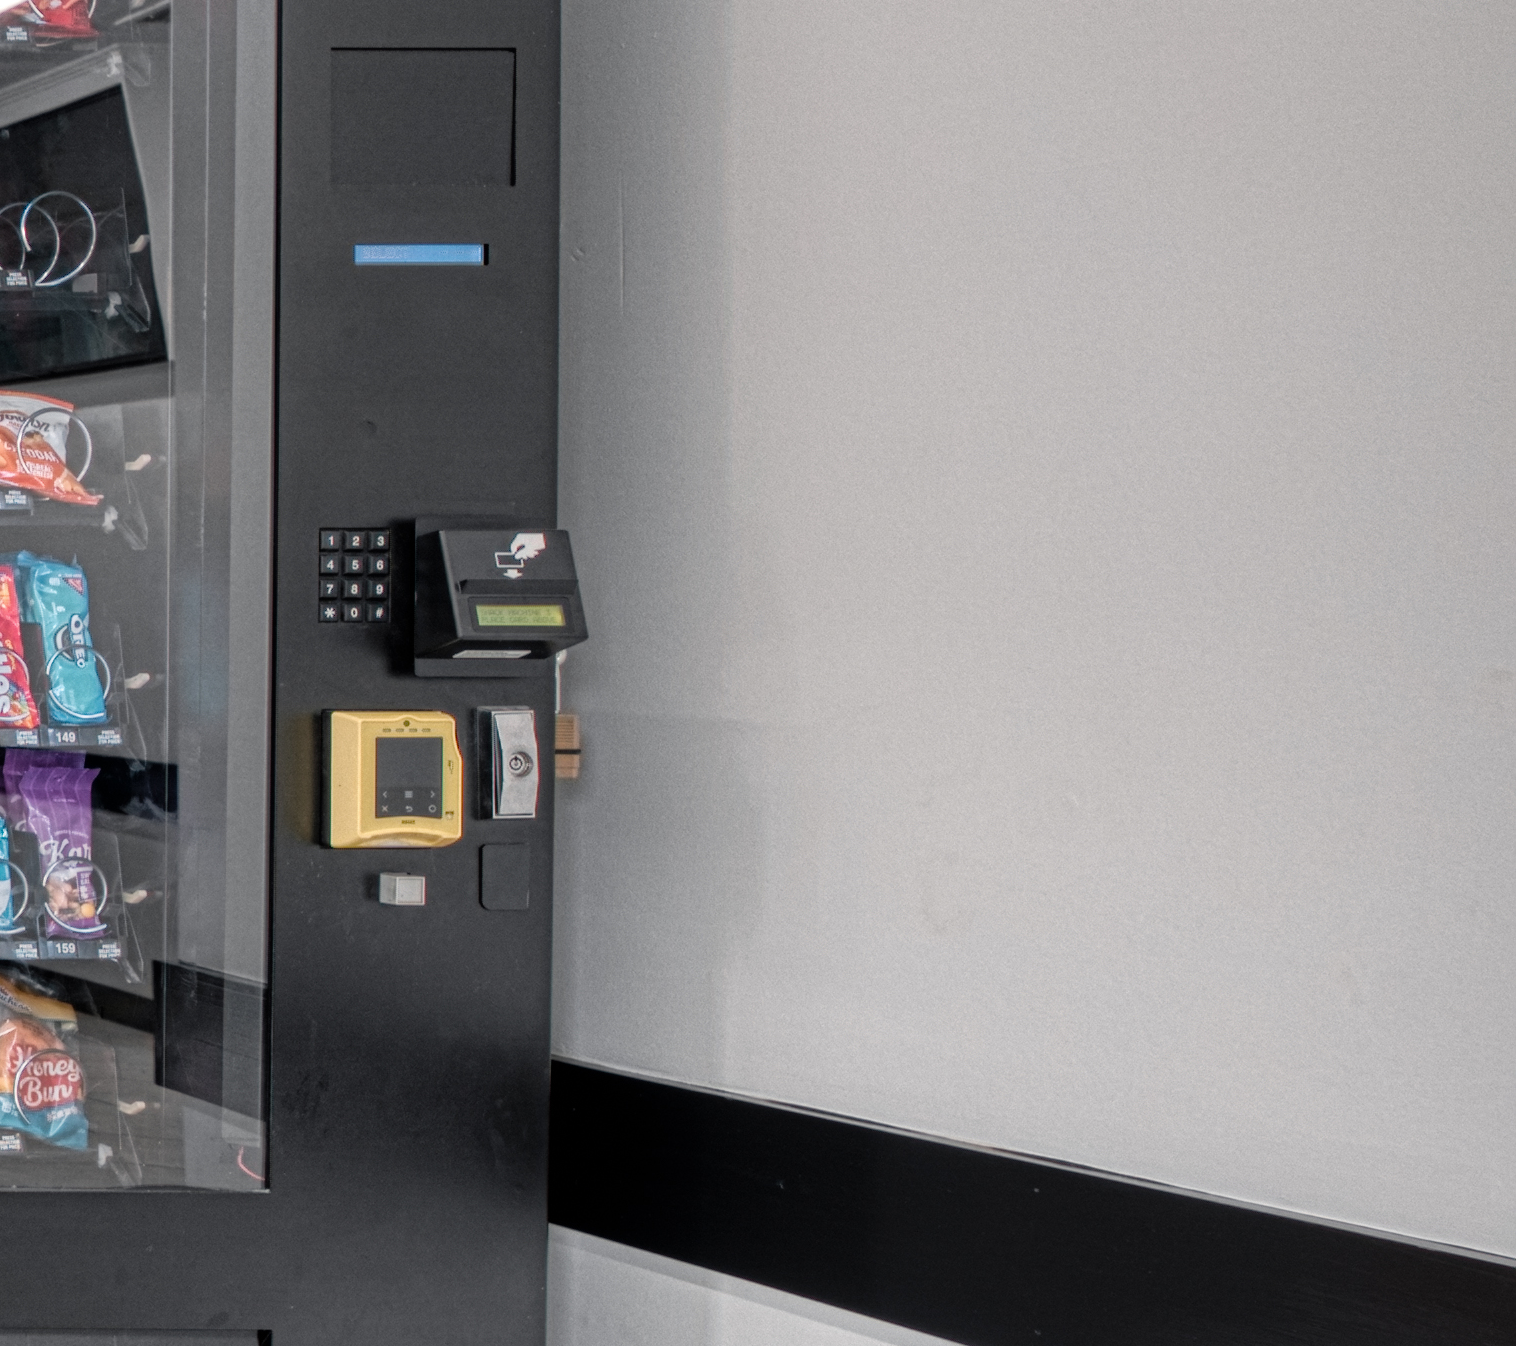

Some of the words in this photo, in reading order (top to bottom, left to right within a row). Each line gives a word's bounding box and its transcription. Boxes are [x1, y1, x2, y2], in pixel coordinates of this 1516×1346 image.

[329, 536, 334, 546] 1
[352, 536, 359, 546] 2
[377, 536, 385, 546] 3
[327, 560, 334, 570] 4
[352, 560, 359, 570] 5
[376, 560, 383, 570] 6
[327, 584, 334, 594] 7
[351, 584, 358, 594] 8
[376, 584, 383, 594] 9
[350, 608, 357, 617] 0
[56, 732, 76, 743] 149
[55, 943, 76, 954] 159
[24, 1076, 74, 1107] Bun
